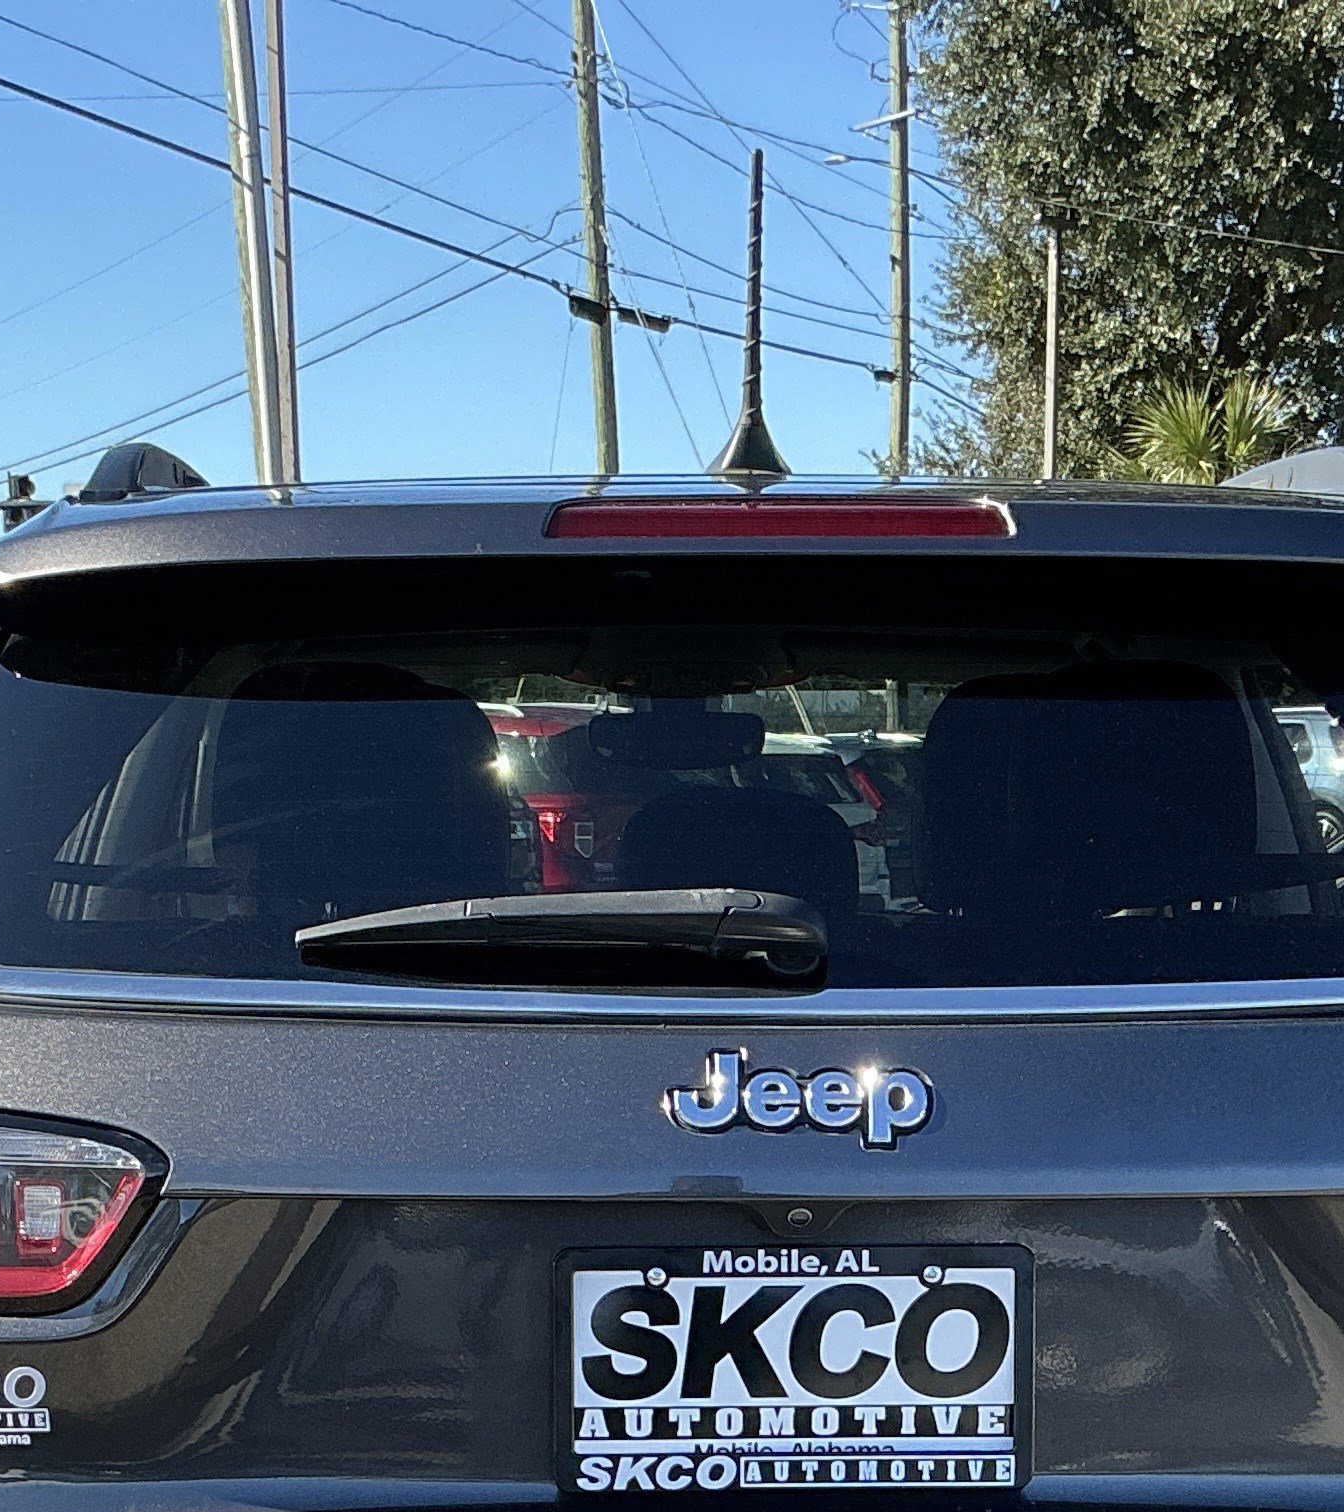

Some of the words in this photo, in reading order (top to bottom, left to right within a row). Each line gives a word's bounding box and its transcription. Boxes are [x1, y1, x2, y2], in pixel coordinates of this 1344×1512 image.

[664, 1047, 936, 1152] Jeep
[701, 1249, 829, 1275] Mobile,
[834, 1249, 880, 1273] AL
[580, 1282, 1011, 1400] SKCO
[578, 1406, 1006, 1438] AUTOMOTIVE
[576, 1455, 738, 1490] SKCO
[745, 1459, 1011, 1482] AUTOMOTIVE
